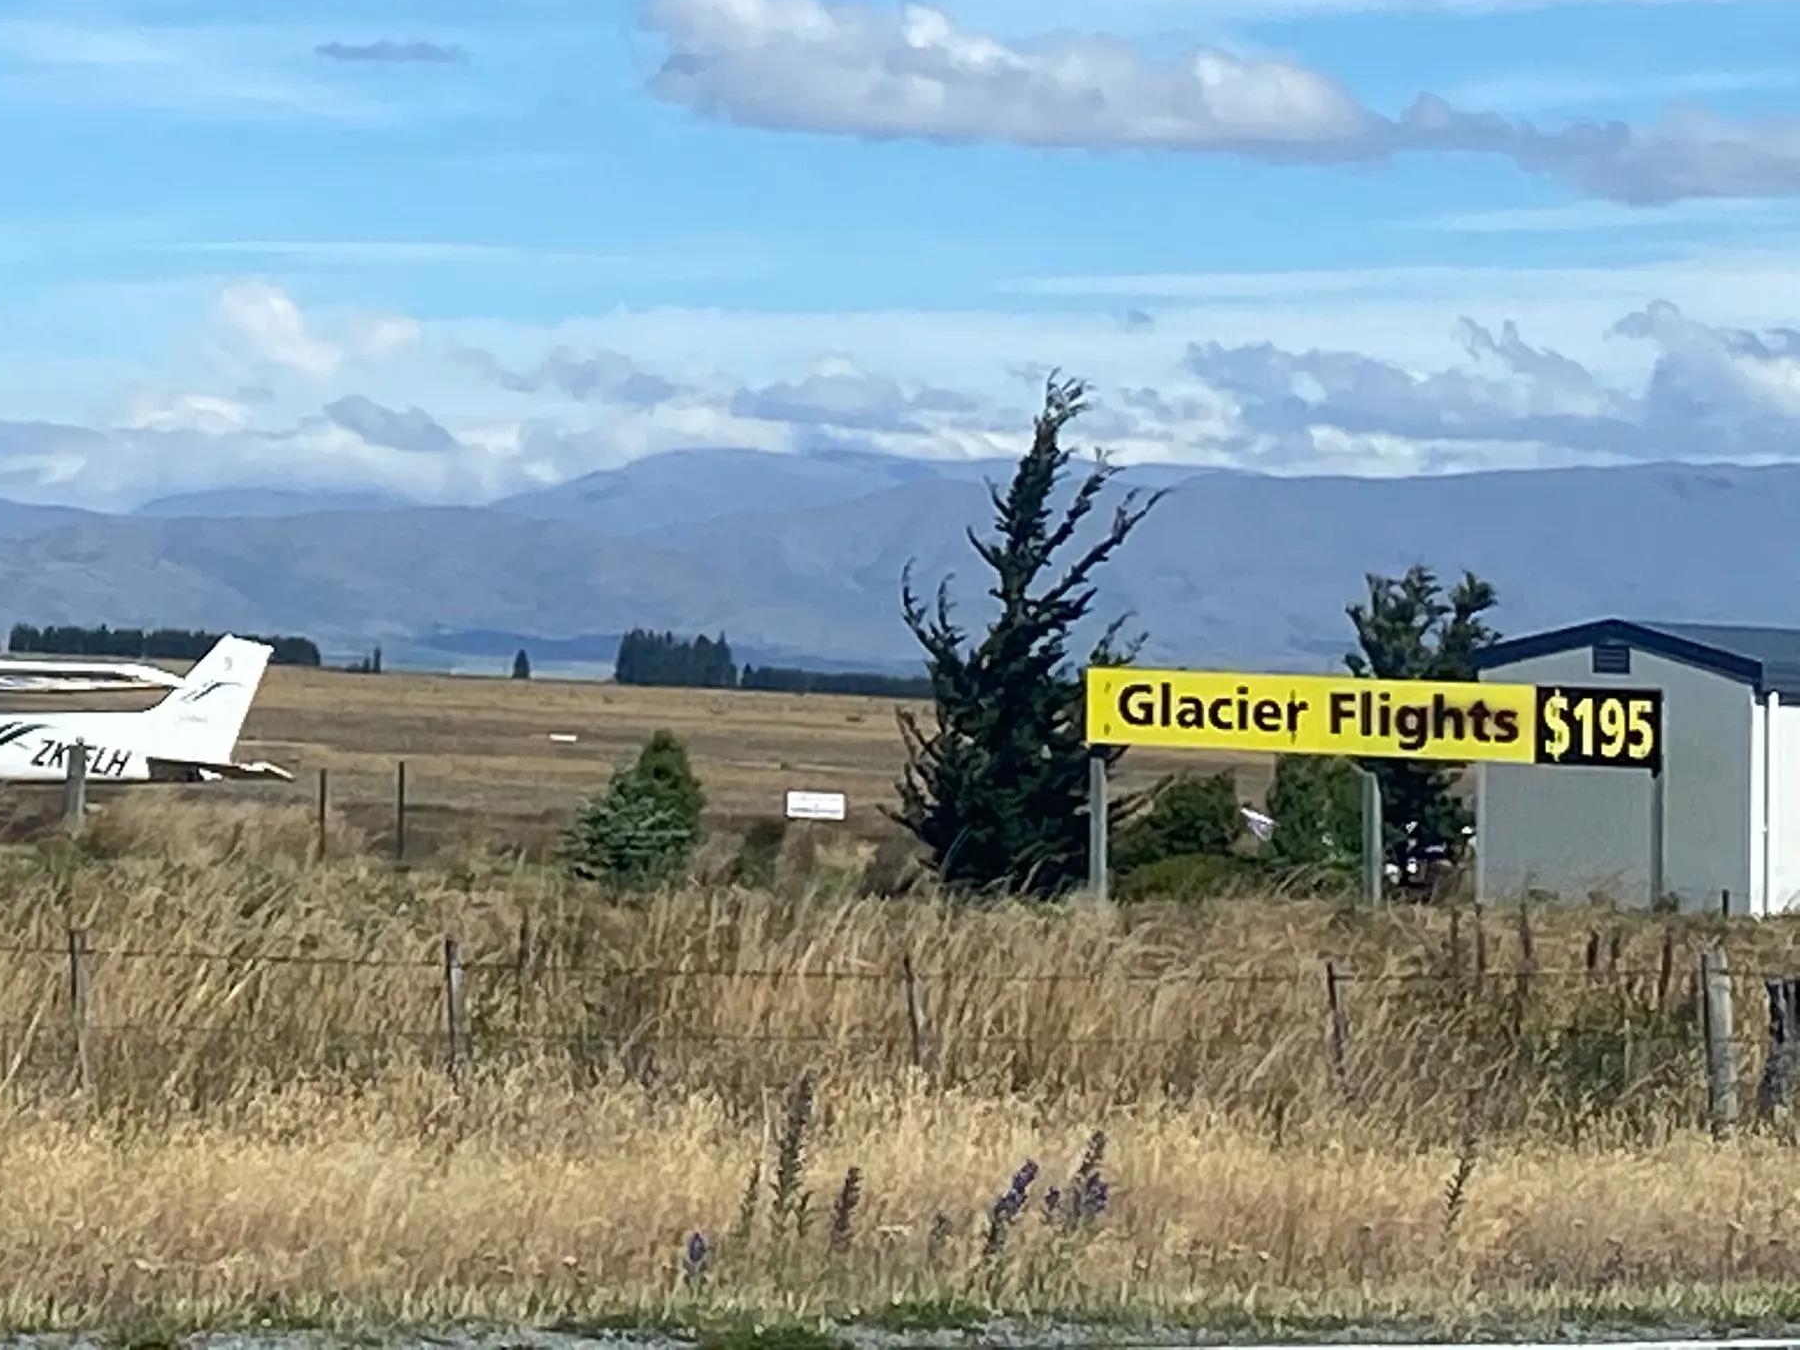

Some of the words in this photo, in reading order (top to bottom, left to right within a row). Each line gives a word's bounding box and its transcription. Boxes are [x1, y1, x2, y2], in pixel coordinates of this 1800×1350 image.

[1117, 682, 1309, 733] Glacier
[1329, 690, 1520, 750] Flights
[1543, 689, 1654, 762] $195
[30, 738, 132, 776] ZKLH
